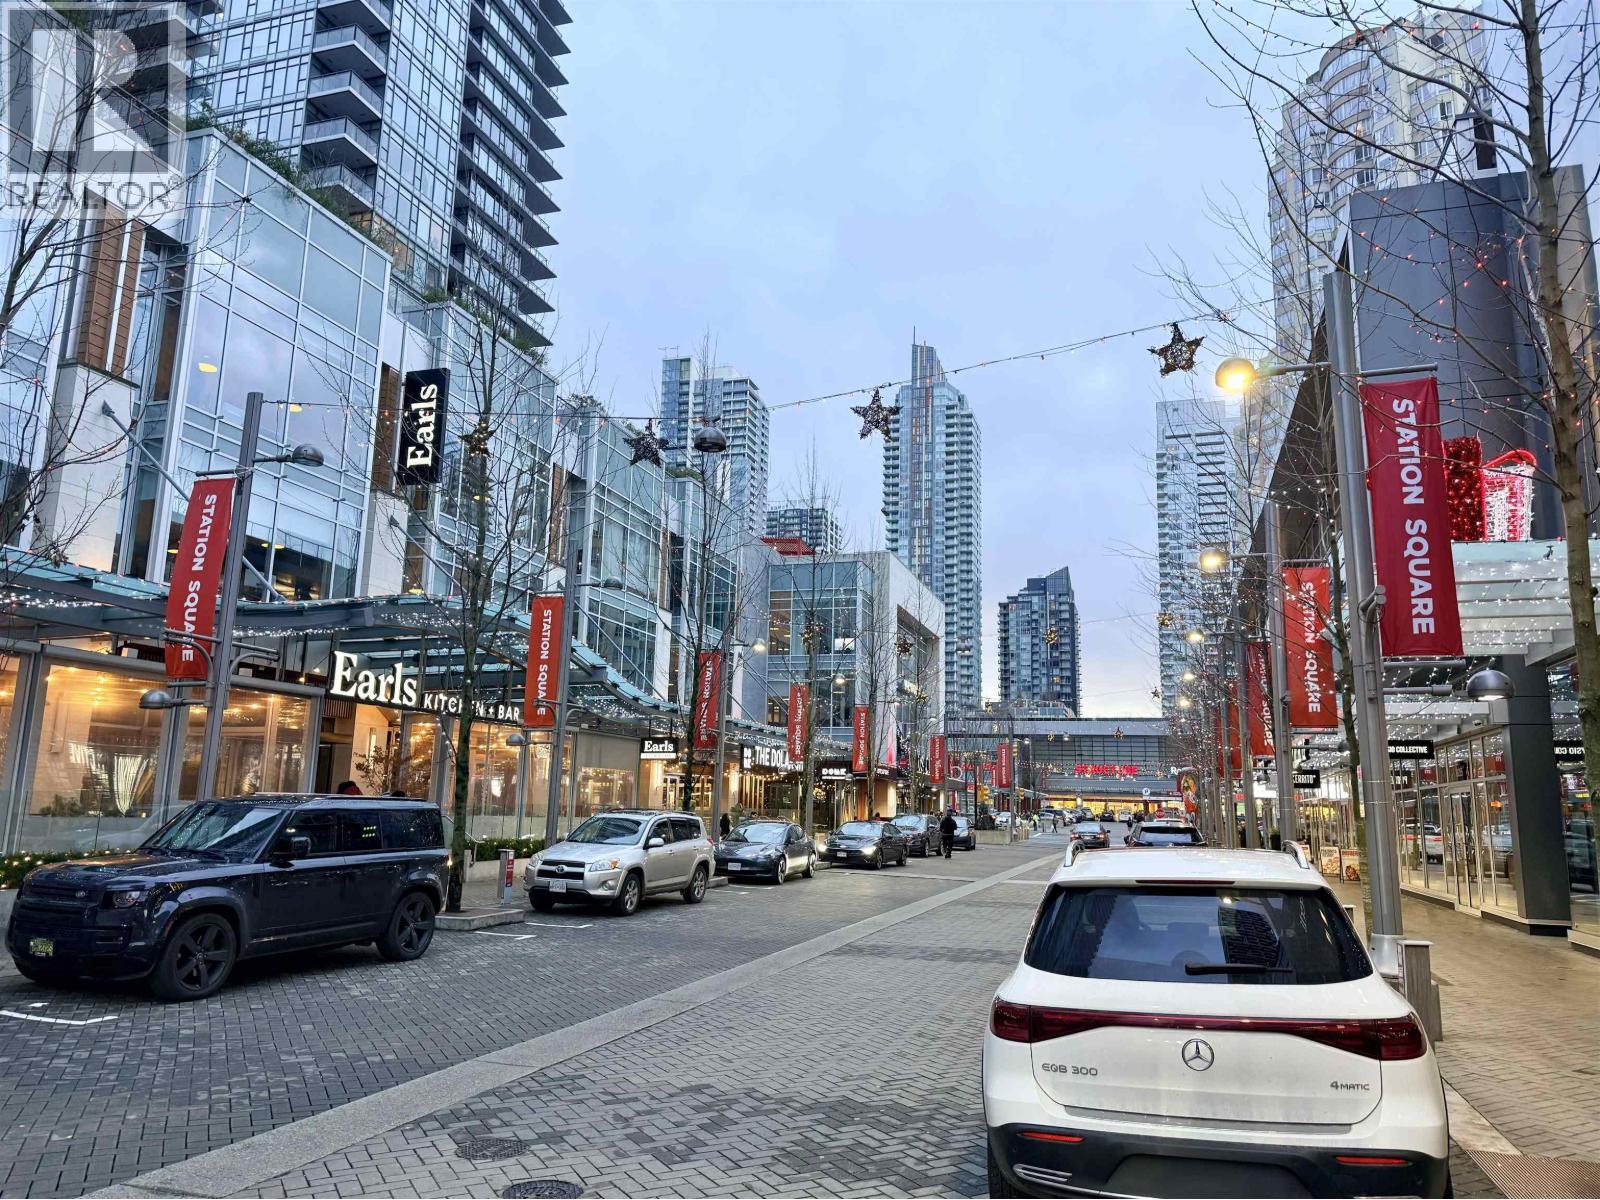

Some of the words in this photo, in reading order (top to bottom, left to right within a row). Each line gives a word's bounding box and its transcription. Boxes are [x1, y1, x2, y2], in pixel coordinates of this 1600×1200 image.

[406, 384, 438, 468] Earls
[1392, 398, 1425, 505] STATION
[191, 494, 217, 571] STATION
[1404, 518, 1435, 635] SQUARE
[539, 609, 552, 660] STATION
[1302, 581, 1317, 644] STATION
[329, 650, 418, 707] Earls
[537, 664, 549, 716] SQUAE
[1305, 649, 1321, 713] SQUARE
[423, 693, 485, 717] KITCN
[498, 705, 520, 721] BAR
[643, 740, 674, 752] Earls
[755, 745, 770, 766] THE
[1396, 745, 1428, 754] COLLECTIVE
[1041, 1062, 1068, 1074] EQB
[1071, 1065, 1098, 1076] 300
